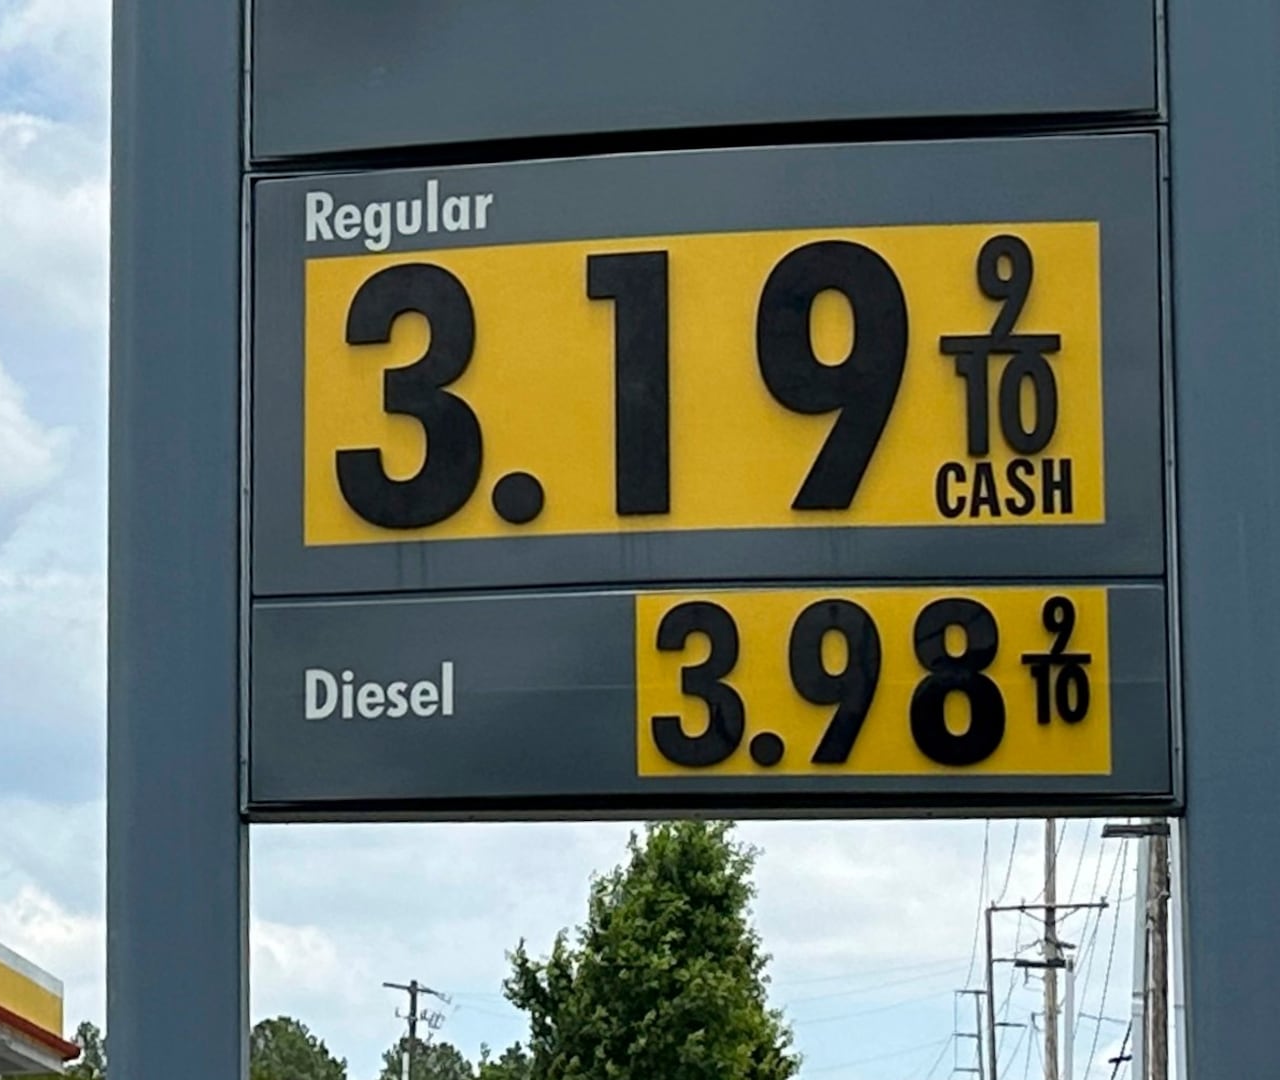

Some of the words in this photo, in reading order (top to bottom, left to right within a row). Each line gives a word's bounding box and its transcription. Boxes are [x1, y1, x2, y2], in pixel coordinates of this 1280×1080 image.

[306, 179, 493, 251] Regular
[335, 240, 908, 530] 3.19
[935, 458, 1073, 520] CASH
[305, 661, 454, 720] Diesel
[651, 598, 1007, 769] 3.98
